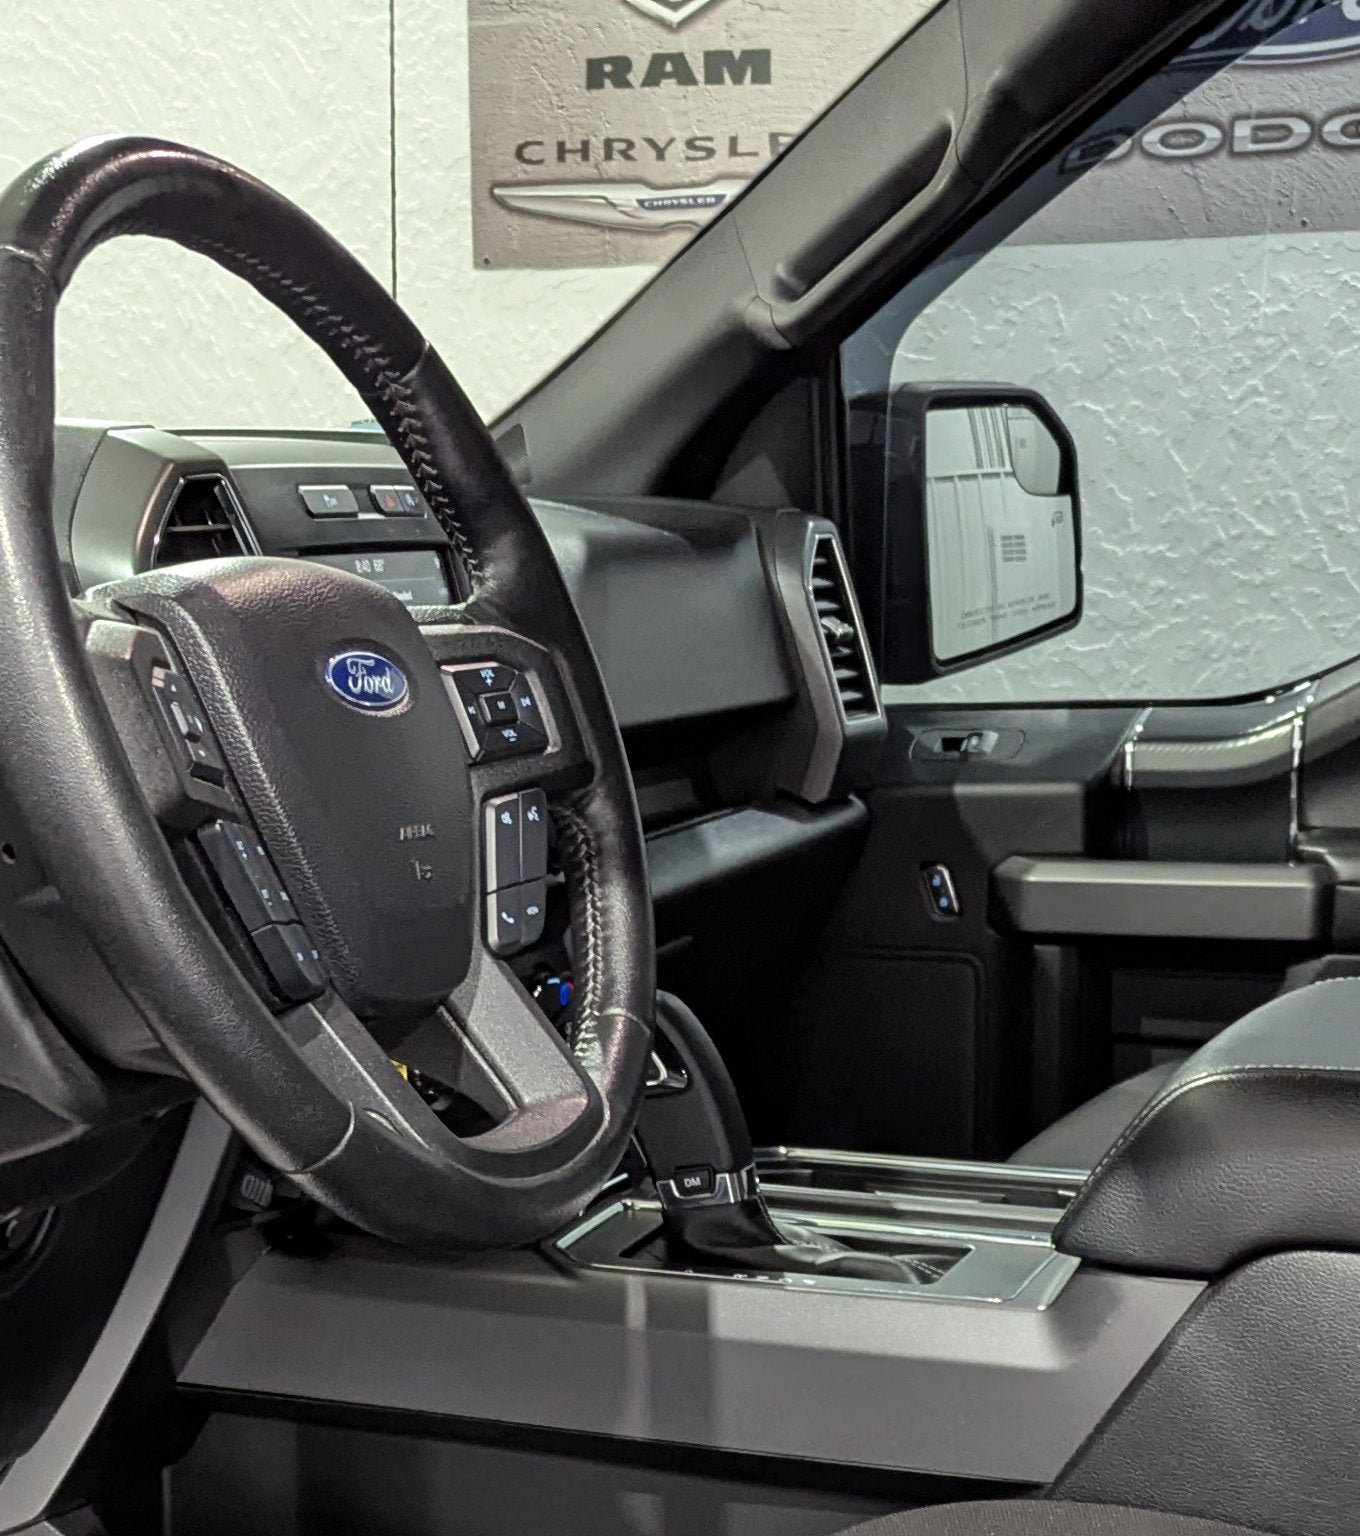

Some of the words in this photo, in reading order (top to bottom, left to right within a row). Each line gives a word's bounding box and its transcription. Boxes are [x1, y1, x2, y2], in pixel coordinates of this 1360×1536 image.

[586, 48, 771, 90] RAM
[514, 131, 798, 165] CHRYSLE
[643, 196, 716, 208] CHRYSLER
[346, 657, 394, 695] Ford
